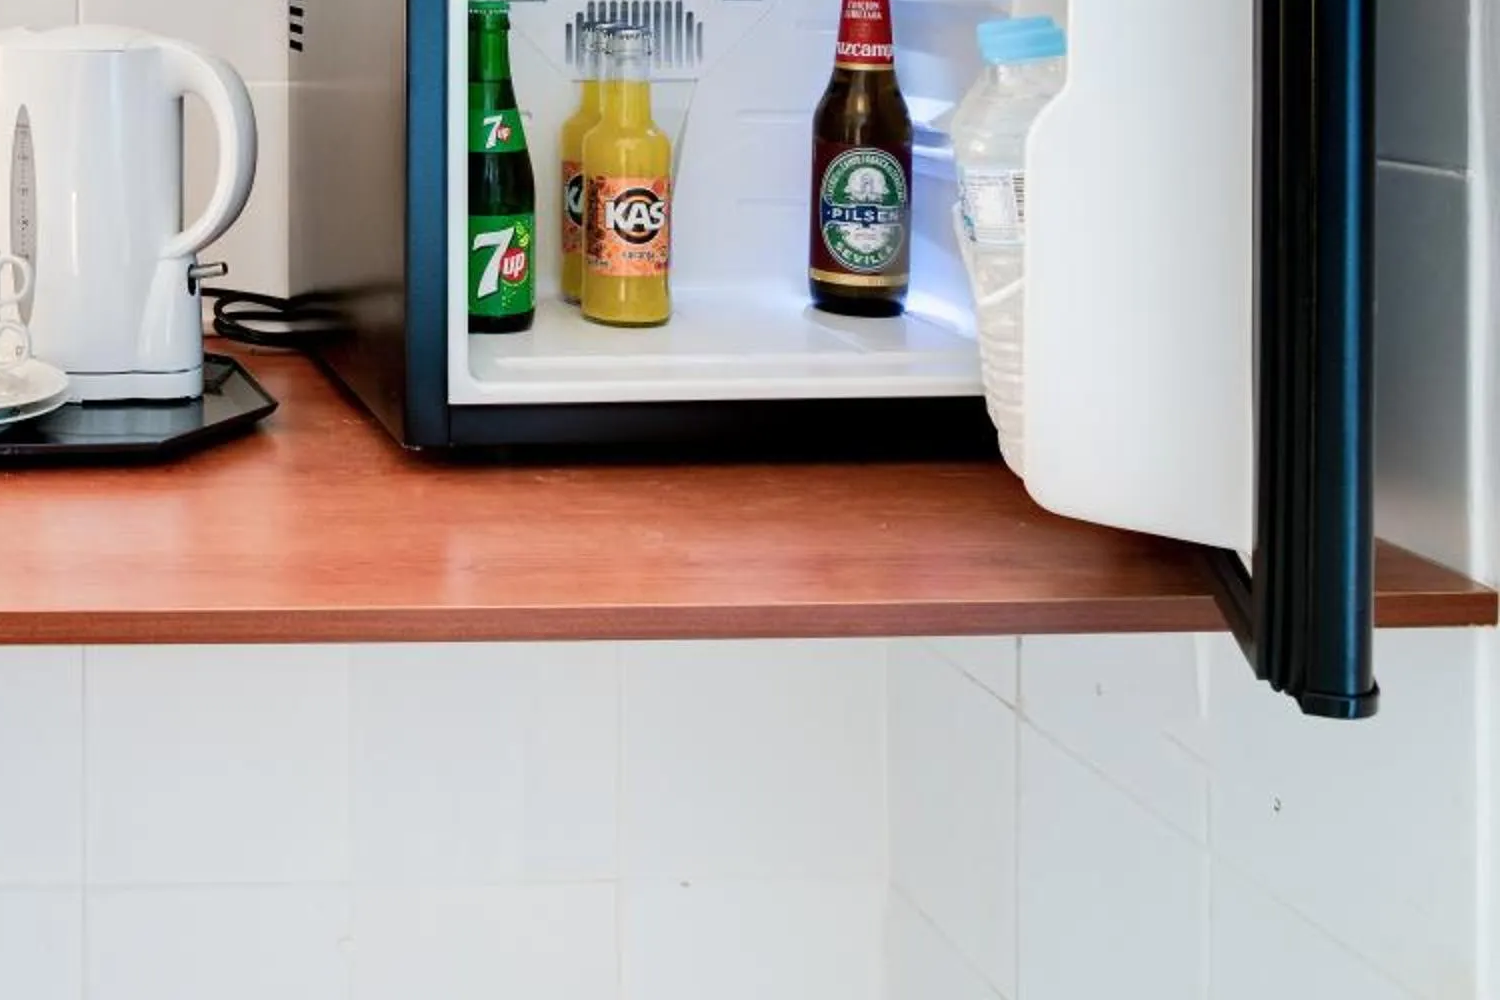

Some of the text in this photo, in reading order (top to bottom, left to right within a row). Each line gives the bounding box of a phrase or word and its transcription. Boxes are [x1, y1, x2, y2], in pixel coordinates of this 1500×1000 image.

[836, 42, 893, 60] uzcamp
[604, 200, 665, 230] KAS
[832, 208, 900, 222] PILSEN
